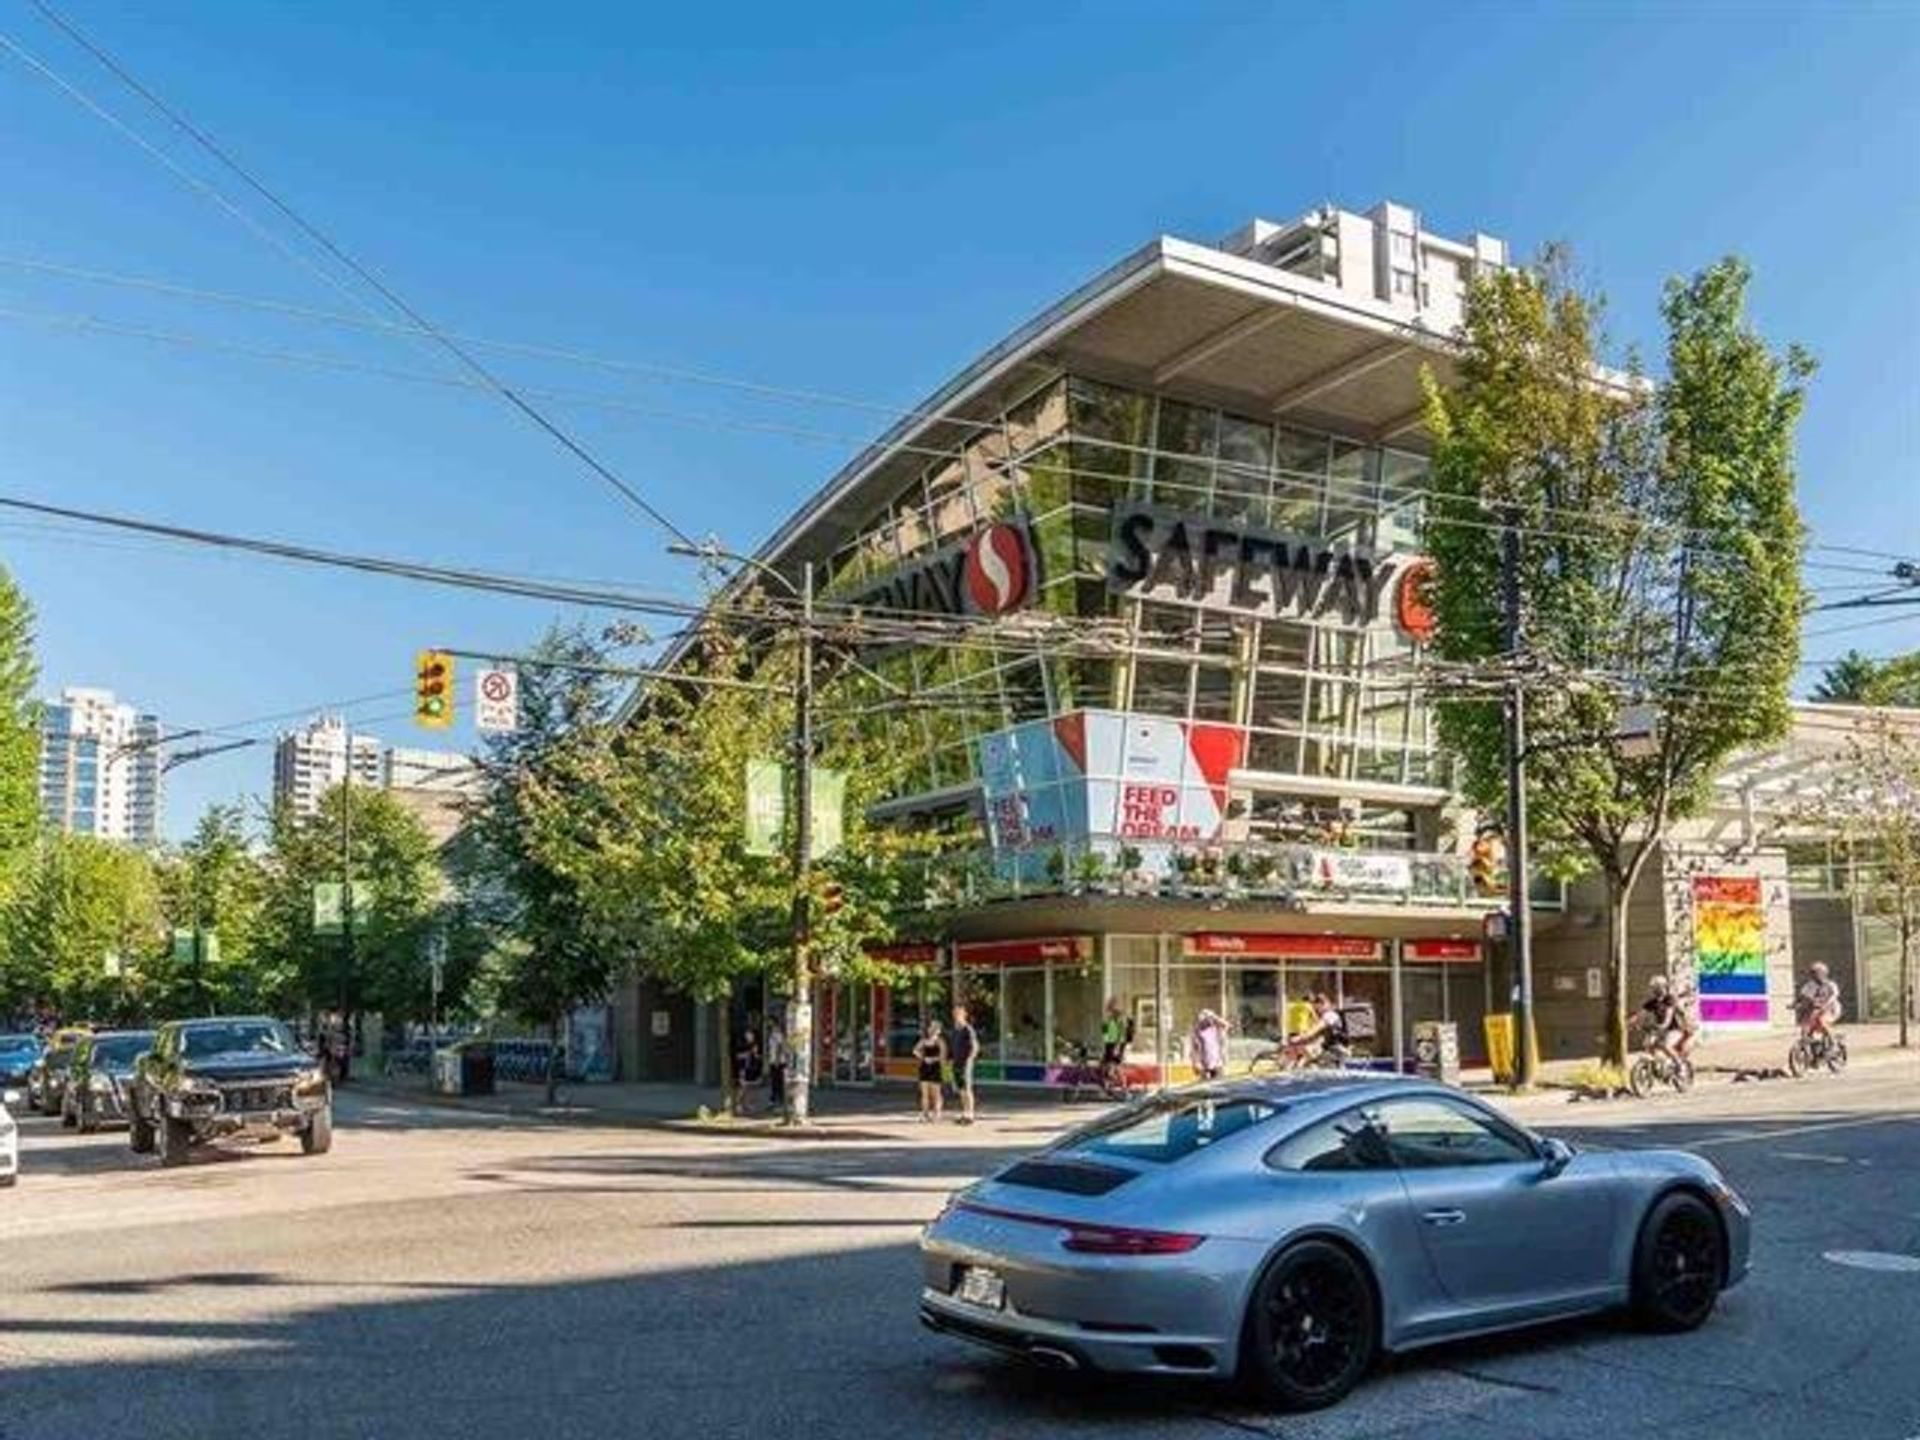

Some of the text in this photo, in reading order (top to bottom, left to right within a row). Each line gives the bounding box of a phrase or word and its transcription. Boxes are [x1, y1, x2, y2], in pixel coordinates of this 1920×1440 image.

[1114, 513, 1397, 626] SAFEWAY
[1125, 785, 1176, 806] FEED
[1124, 803, 1163, 823] THE
